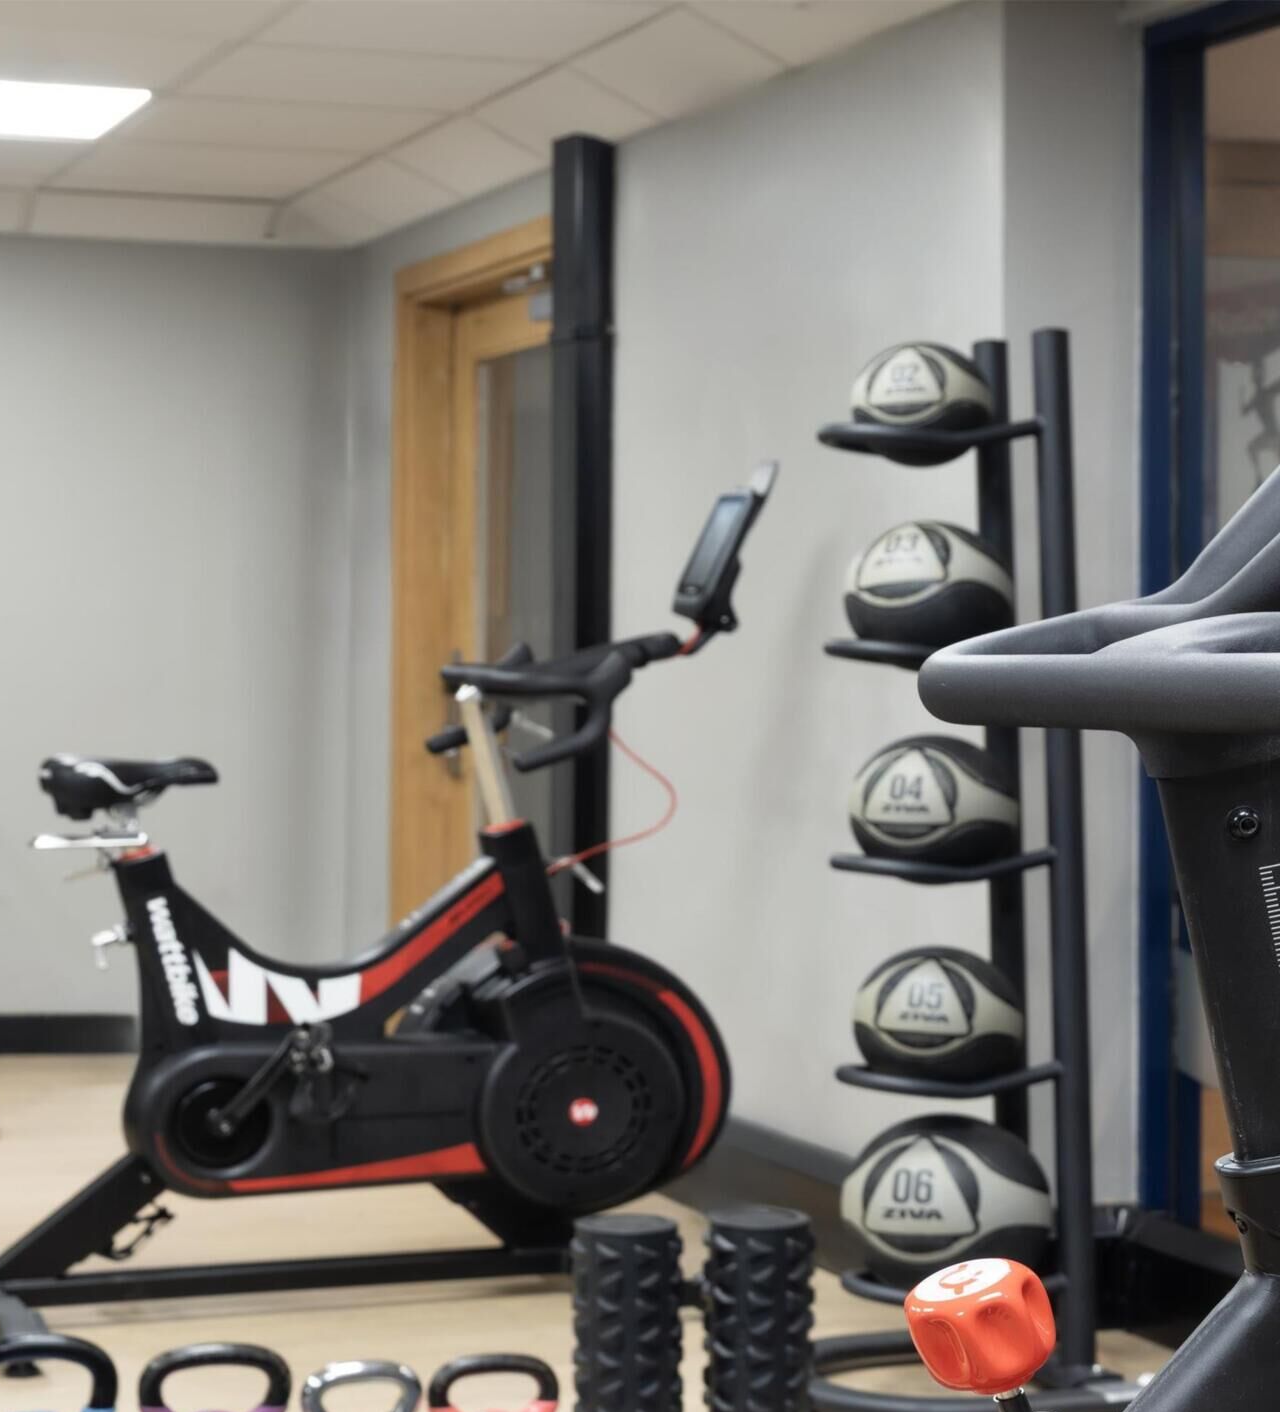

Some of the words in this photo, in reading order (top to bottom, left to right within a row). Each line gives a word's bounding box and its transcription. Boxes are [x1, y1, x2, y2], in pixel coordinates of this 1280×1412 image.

[890, 773, 924, 801] 04
[146, 896, 199, 1027] wattbike
[907, 981, 943, 1009] 05
[893, 1167, 933, 1203] 06
[883, 1208, 943, 1219] ZIVA
